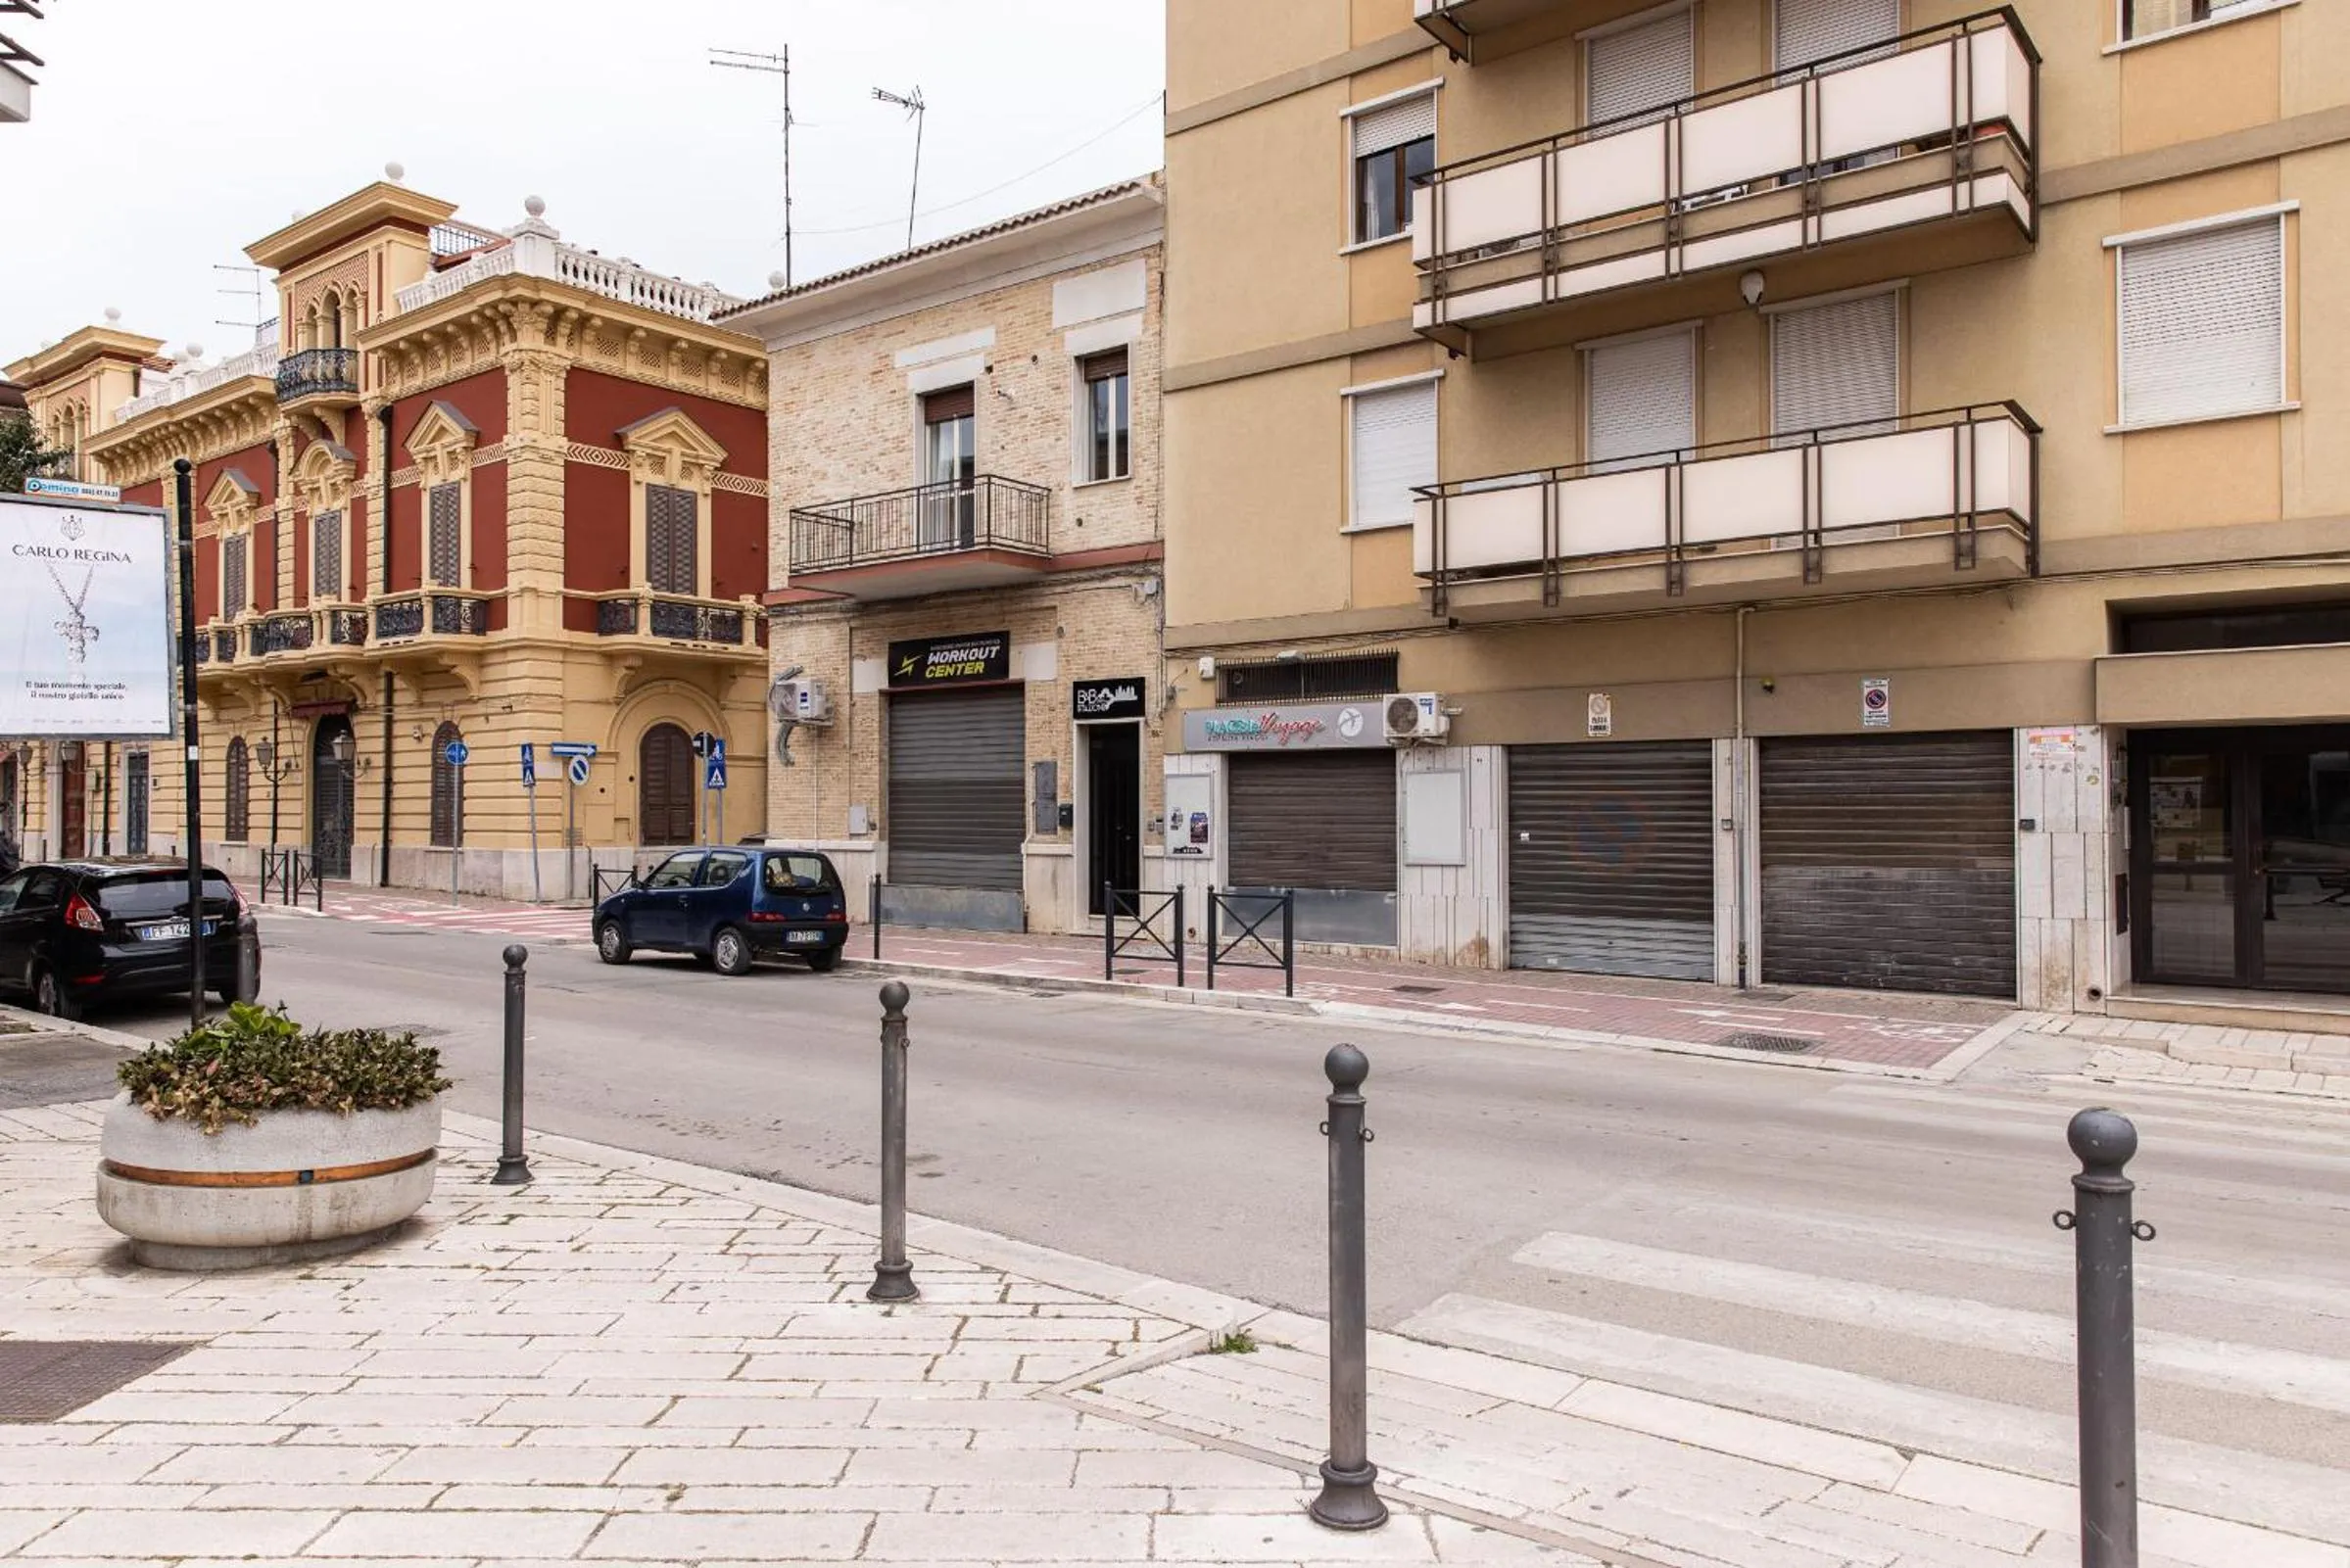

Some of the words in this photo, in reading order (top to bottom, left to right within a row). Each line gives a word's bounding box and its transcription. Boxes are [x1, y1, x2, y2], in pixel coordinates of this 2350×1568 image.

[27, 479, 79, 494] Domino
[12, 544, 69, 559] CARLO
[73, 548, 132, 563] REGINA
[927, 645, 1000, 665] WORKOUT
[925, 661, 985, 678] CENTER
